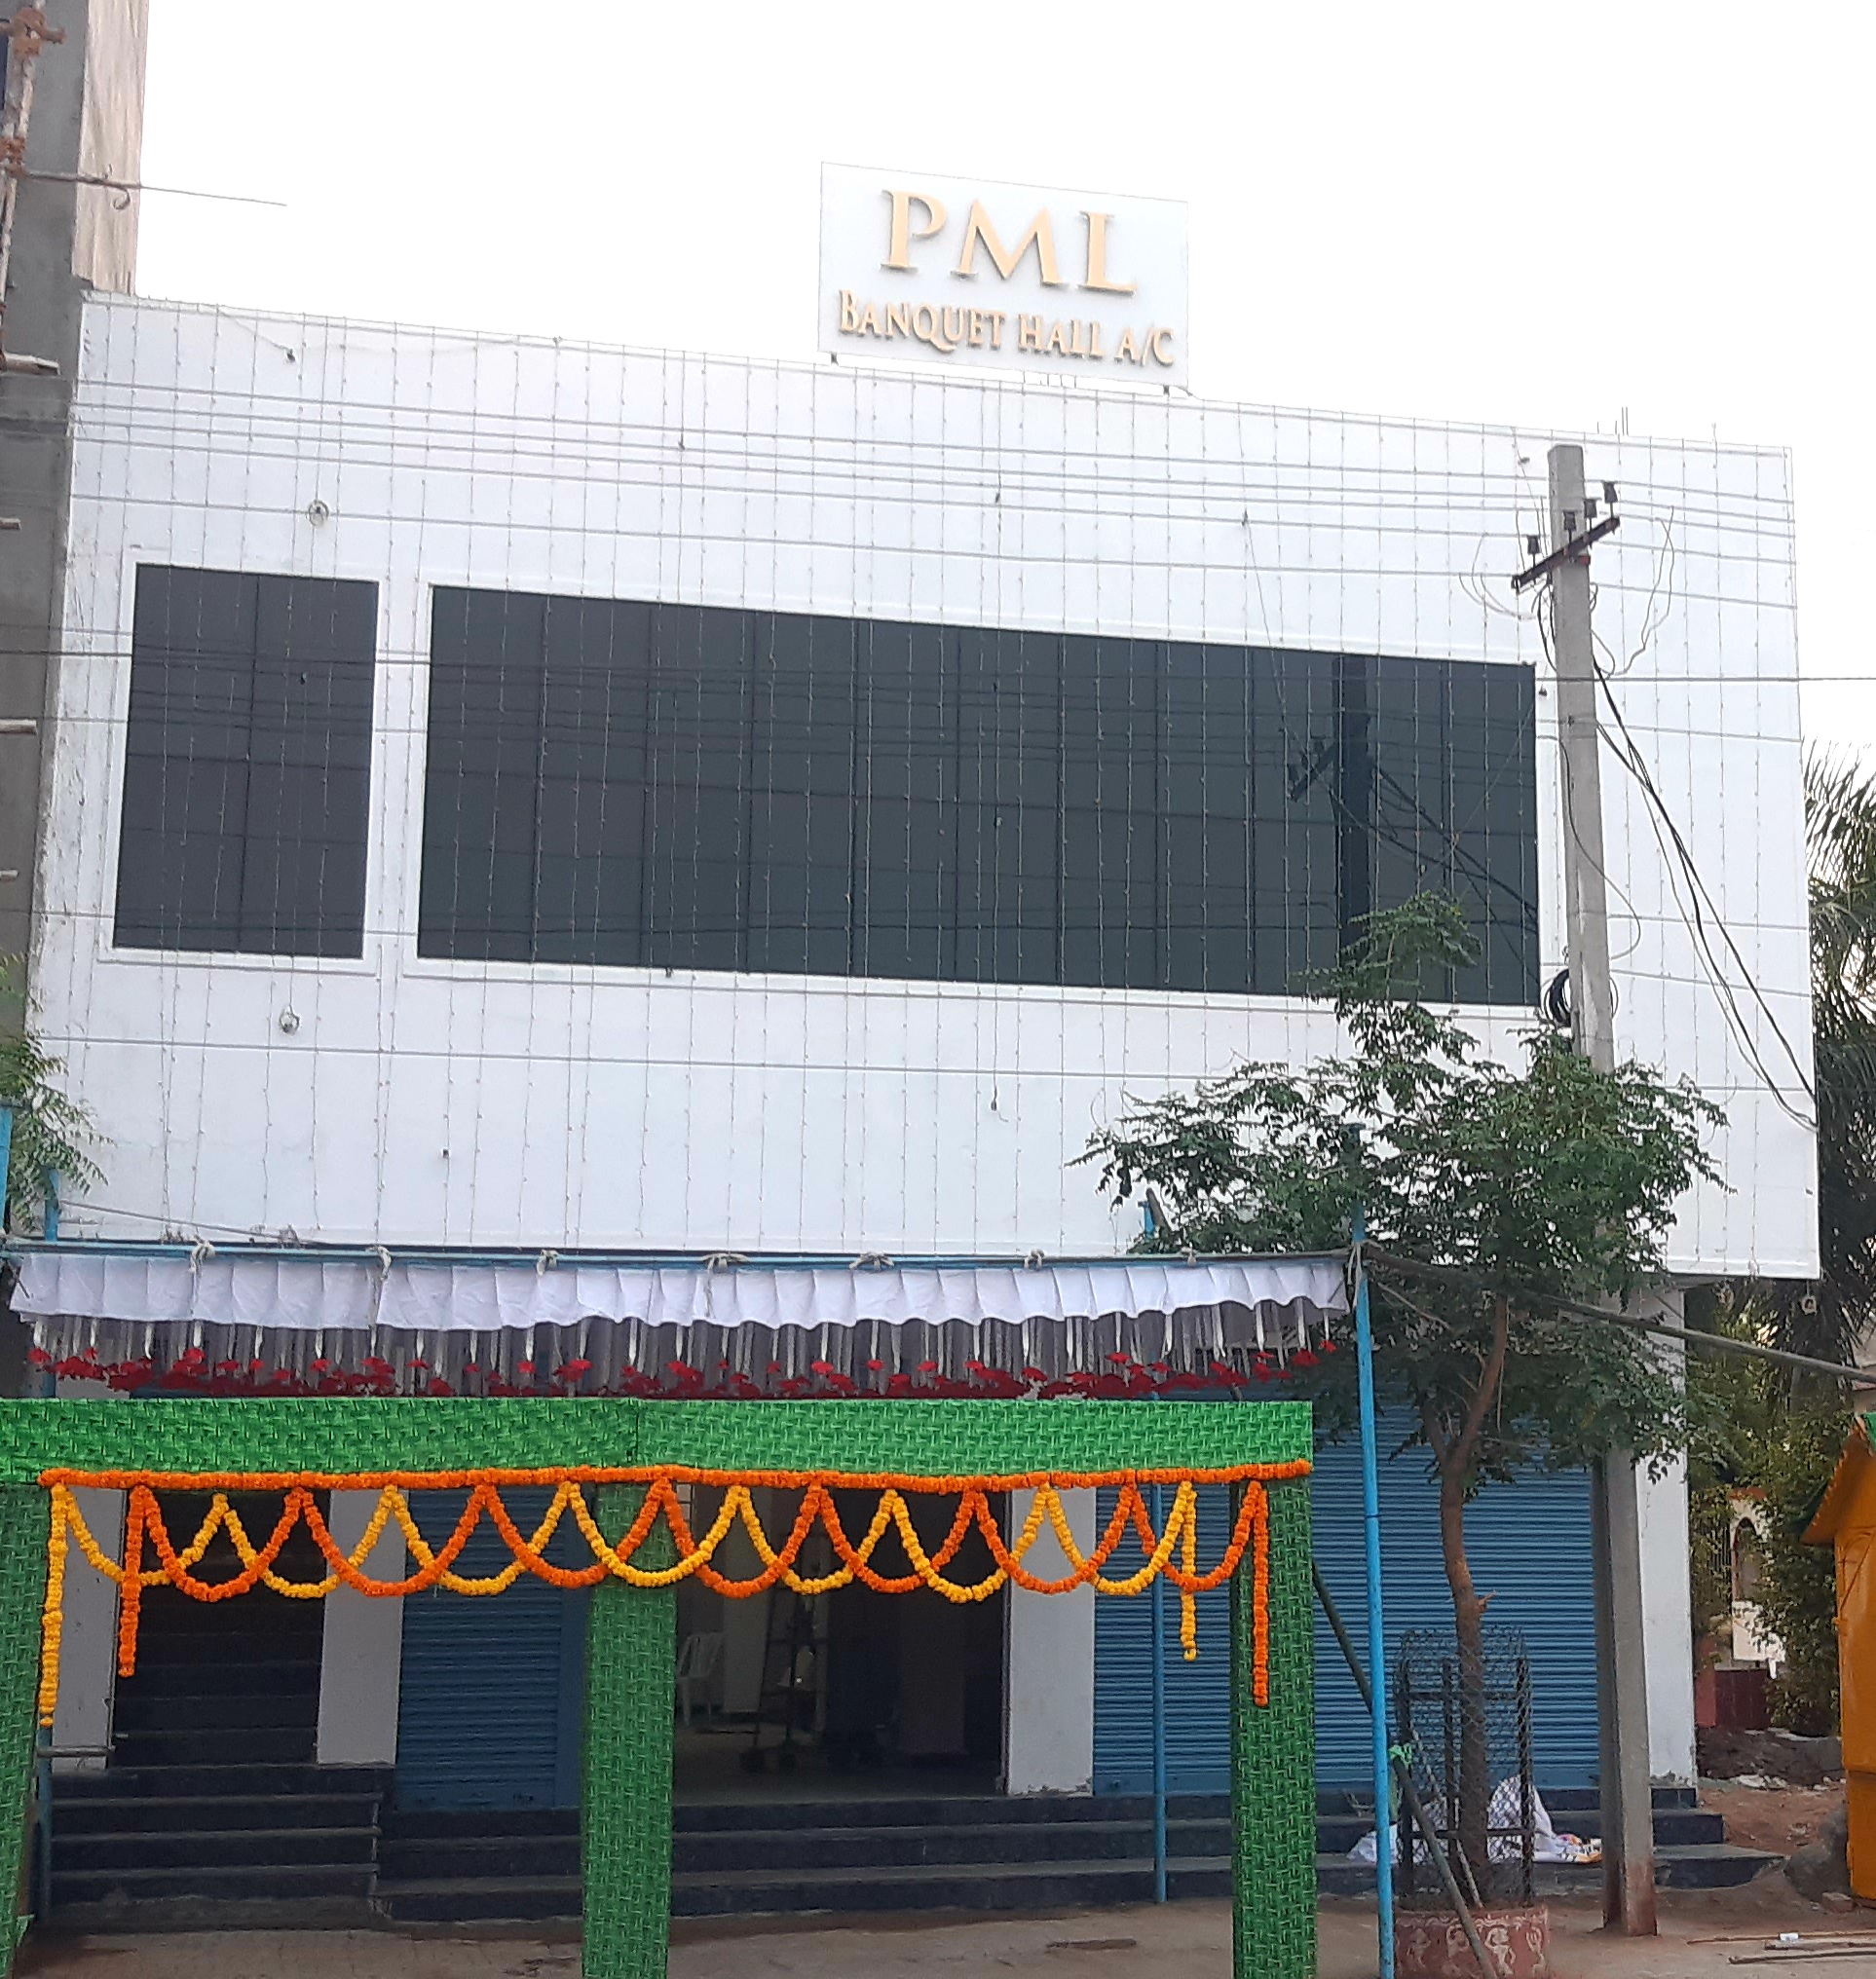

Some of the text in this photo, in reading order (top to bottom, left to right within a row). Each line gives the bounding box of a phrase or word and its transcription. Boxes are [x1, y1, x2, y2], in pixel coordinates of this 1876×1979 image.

[881, 190, 1137, 295] PML
[839, 289, 1175, 367] BANQUET HALL A/C
